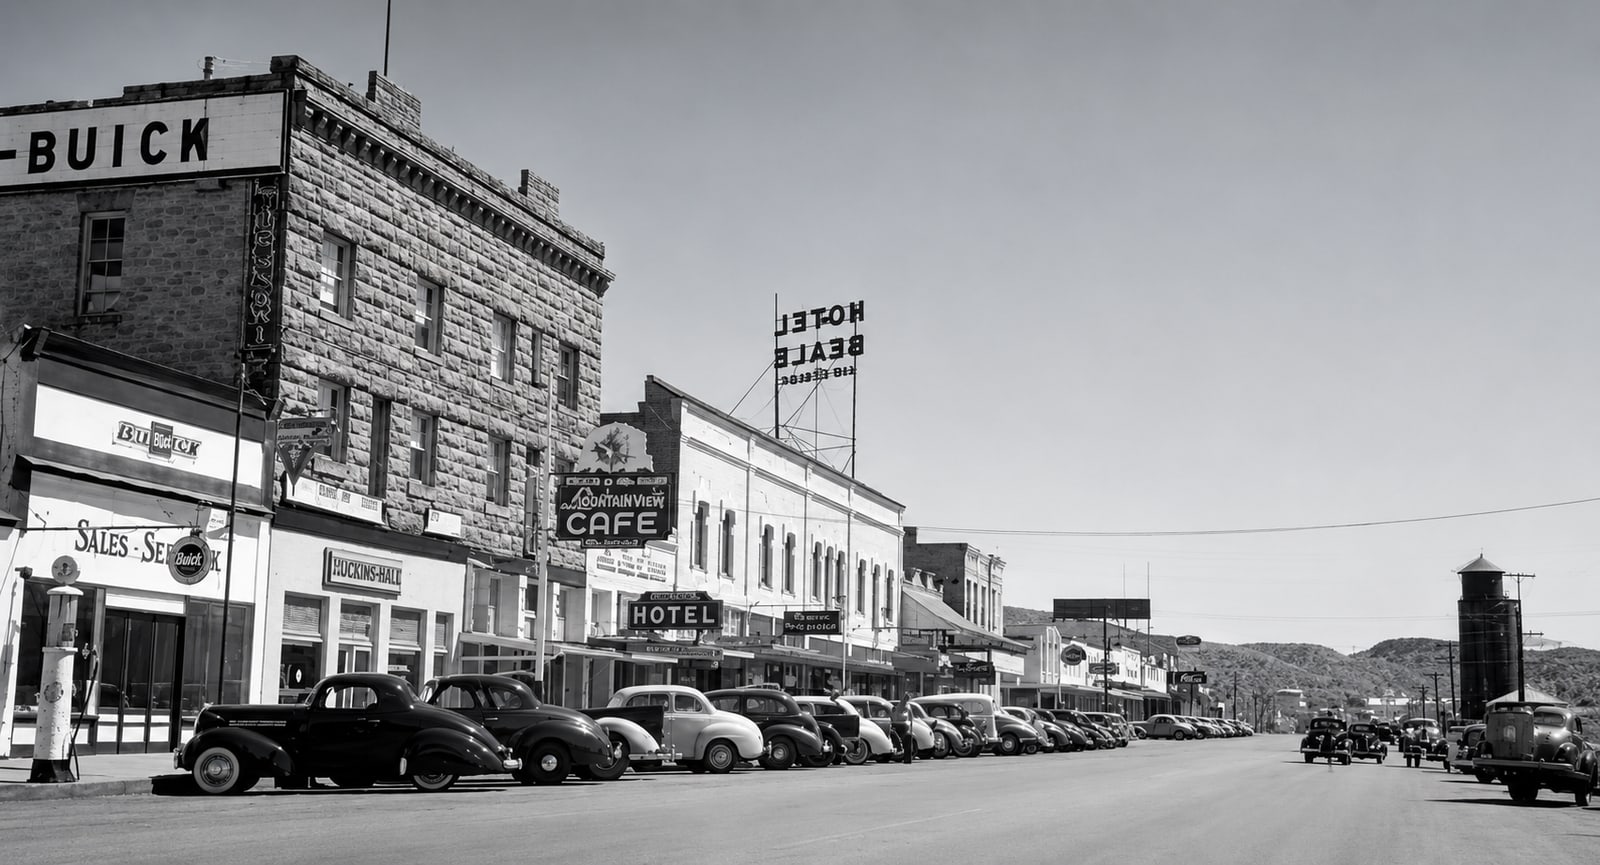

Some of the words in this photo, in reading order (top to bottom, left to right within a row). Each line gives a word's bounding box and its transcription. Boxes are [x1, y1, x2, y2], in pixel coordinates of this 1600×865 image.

[633, 493, 666, 510] VIEW
[566, 511, 658, 536] CAFE
[75, 519, 128, 558] SALES
[175, 551, 203, 567] Buick
[633, 605, 716, 625] HOTEL
